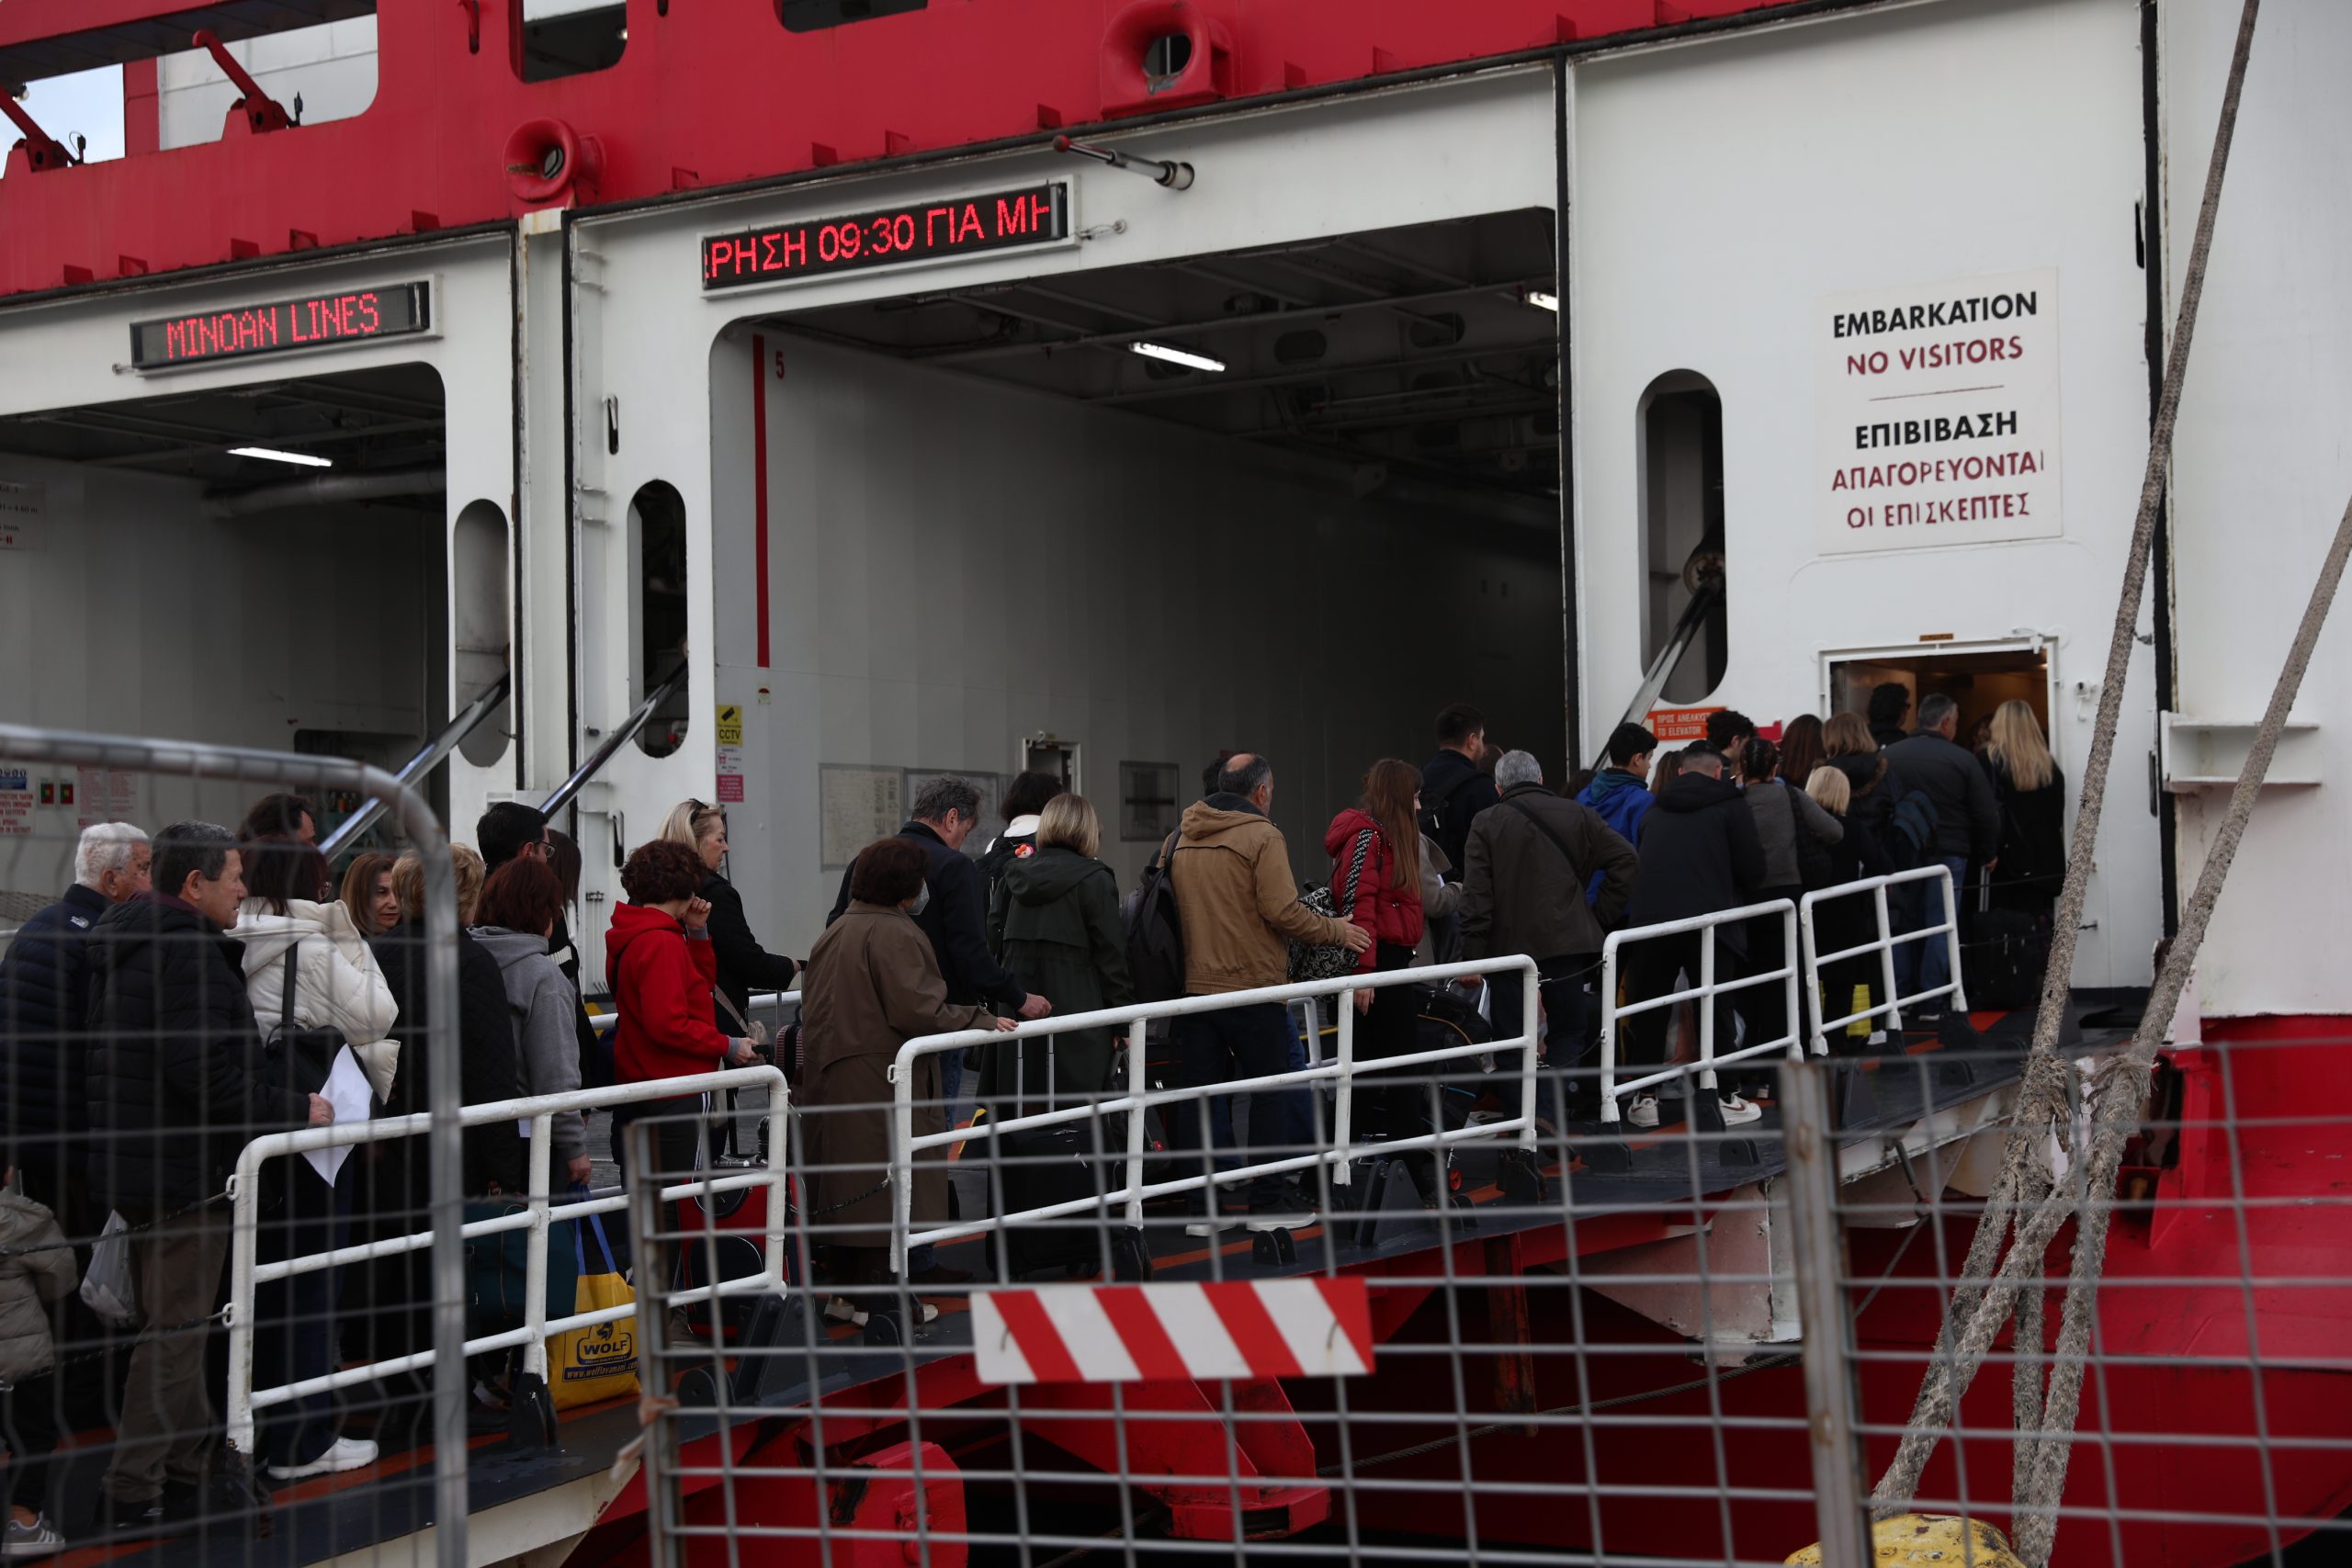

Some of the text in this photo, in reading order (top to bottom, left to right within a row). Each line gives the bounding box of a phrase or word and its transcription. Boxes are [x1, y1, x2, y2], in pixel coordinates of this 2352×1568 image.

[818, 213, 915, 263] 09:30
[926, 202, 985, 247] ΓΙΑ
[166, 292, 379, 359] MINOAN LINES
[1833, 290, 2038, 339] EMBARKATION
[775, 350, 785, 380] 5
[1847, 335, 2023, 376] NO VISITORS
[1855, 410, 2018, 450] ΕΠΙΒΙΒΑΣΗ
[1831, 448, 2044, 491] ΑΠΑΓΟΡΕΥΟΝΤΑΙ
[1847, 491, 2030, 529] ΟΙ ΕΠΙΣΚΕΠΤΕΣ
[718, 728, 741, 740] CCTV
[1657, 726, 1701, 737] TO ELEVATOR
[583, 1340, 628, 1355] WOLF
